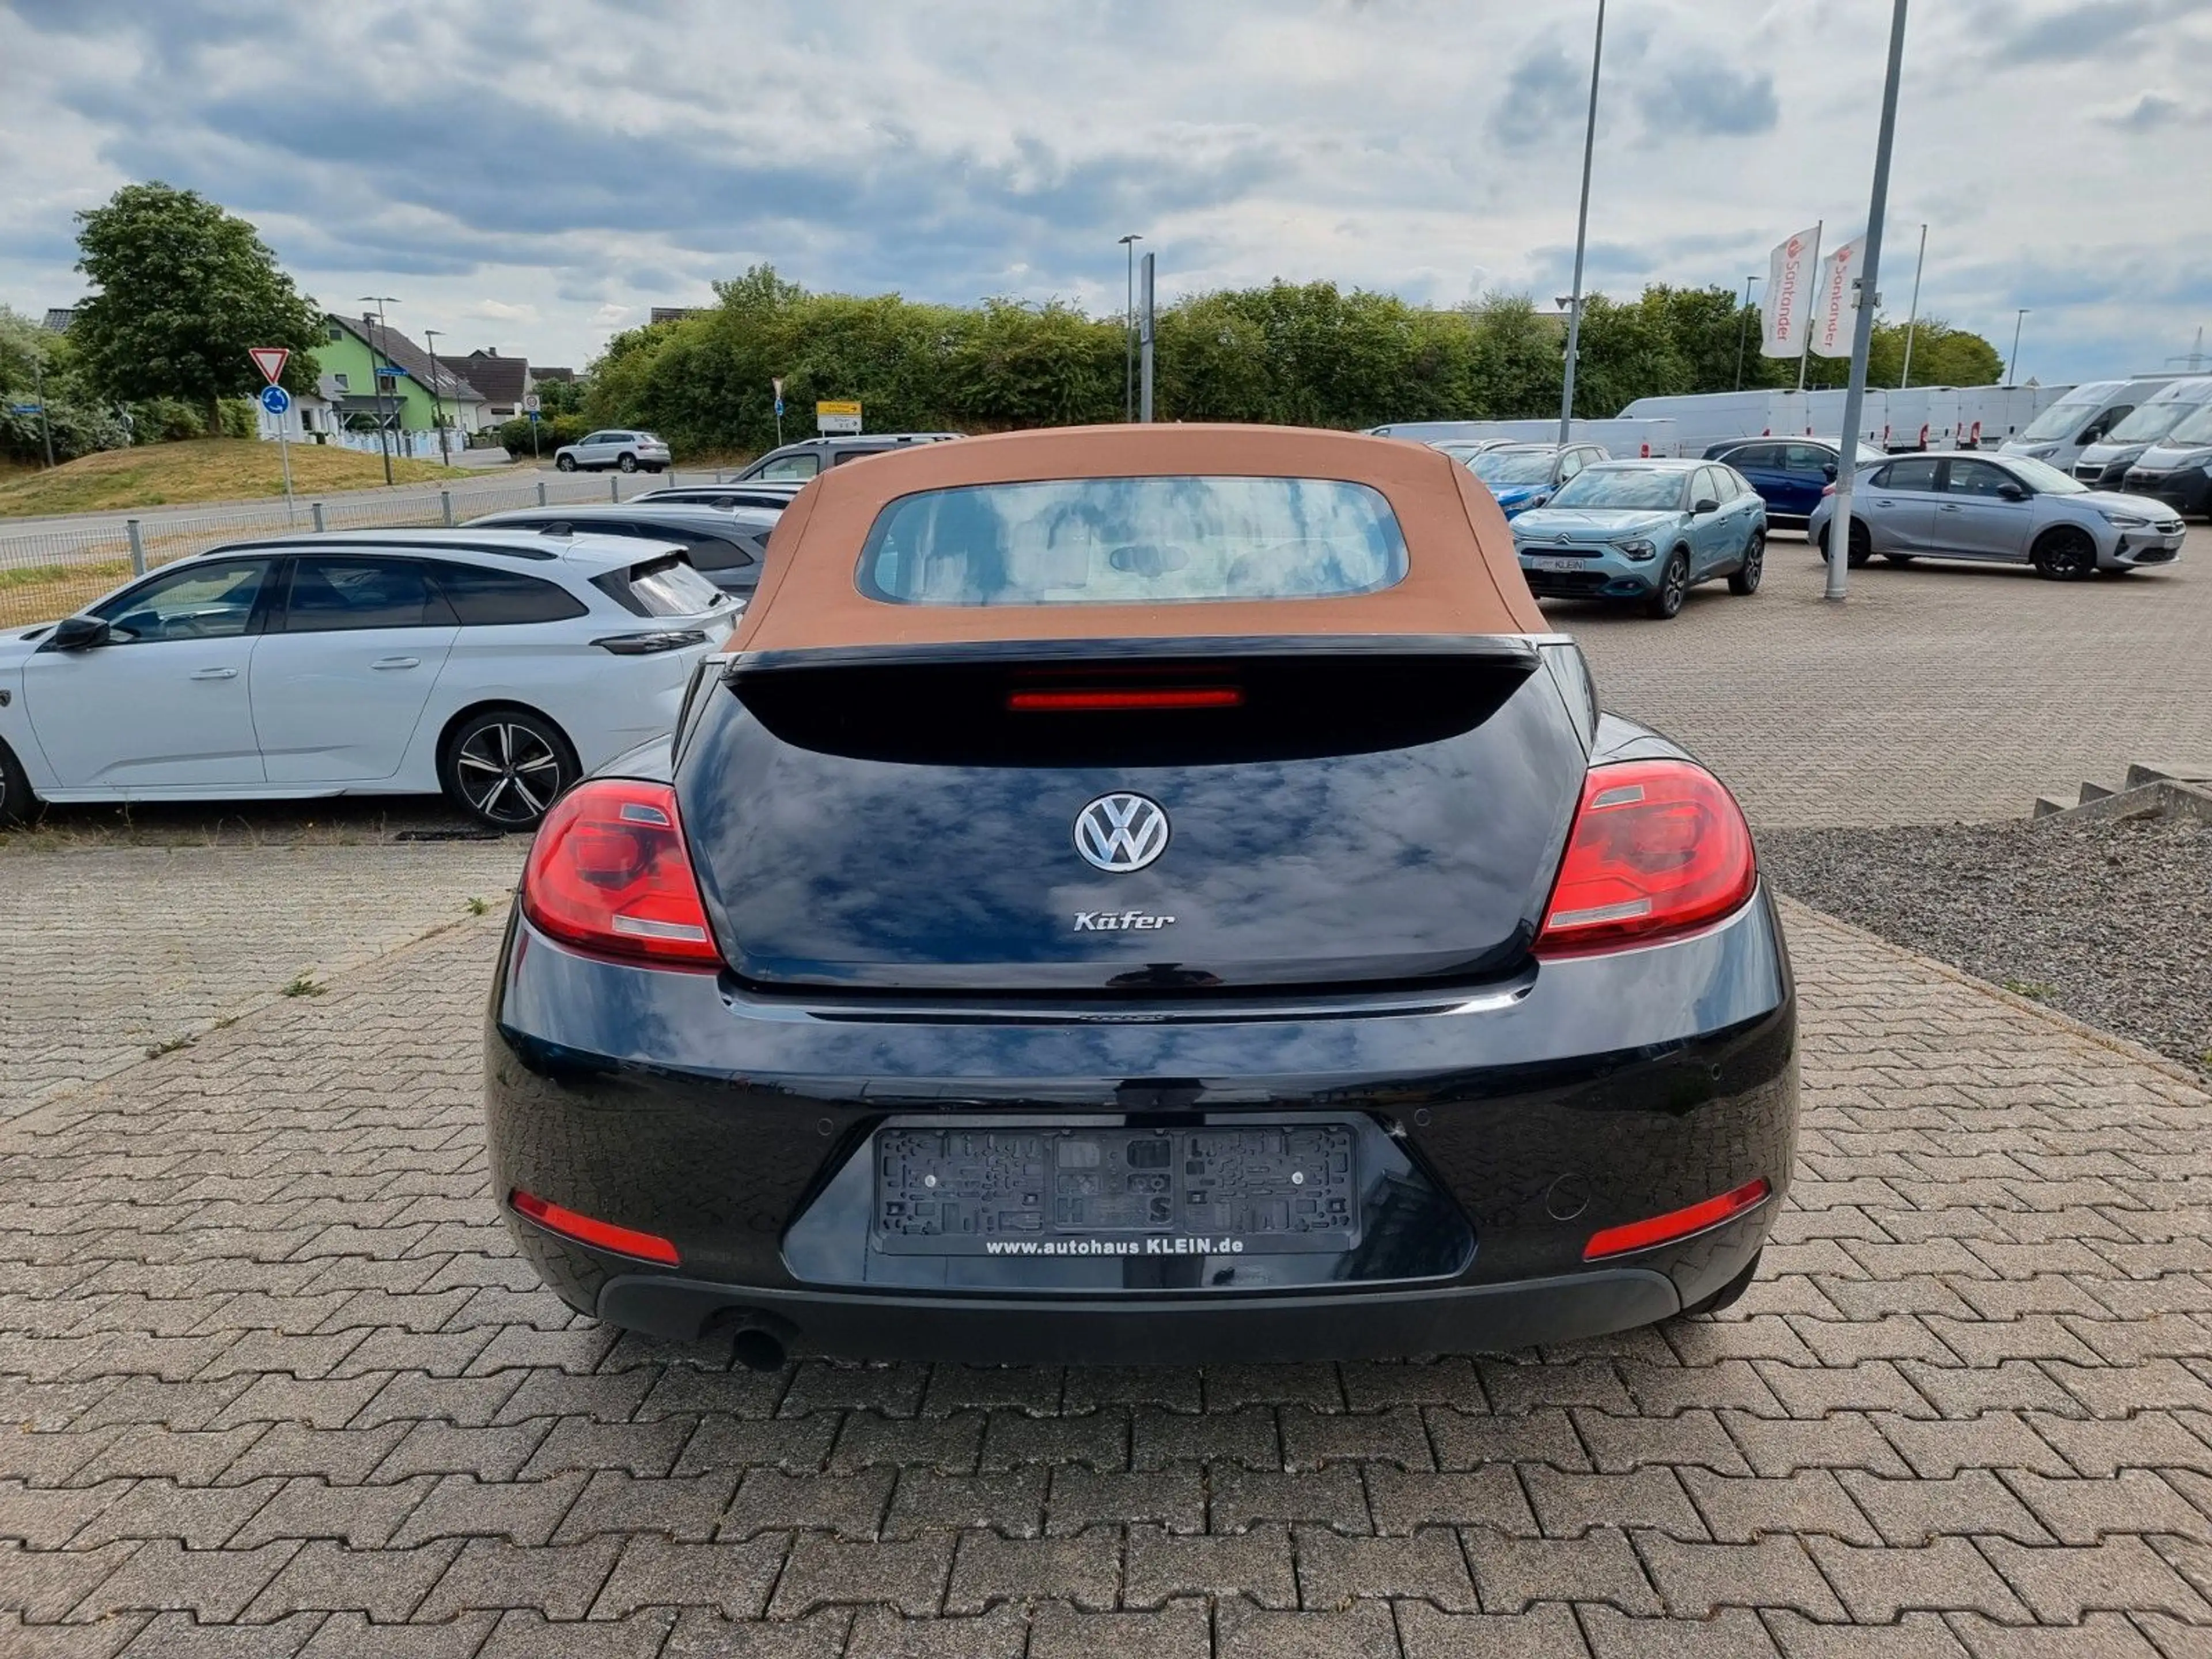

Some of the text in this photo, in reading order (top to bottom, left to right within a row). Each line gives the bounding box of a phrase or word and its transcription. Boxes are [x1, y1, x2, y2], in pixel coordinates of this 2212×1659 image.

[1777, 261, 1800, 341] Santander
[1555, 559, 1582, 570] KLEIN
[1082, 797, 1162, 865] VW
[1073, 911, 1176, 931] Käfer
[986, 1237, 1244, 1255] www.autohaus KLEIN.de
